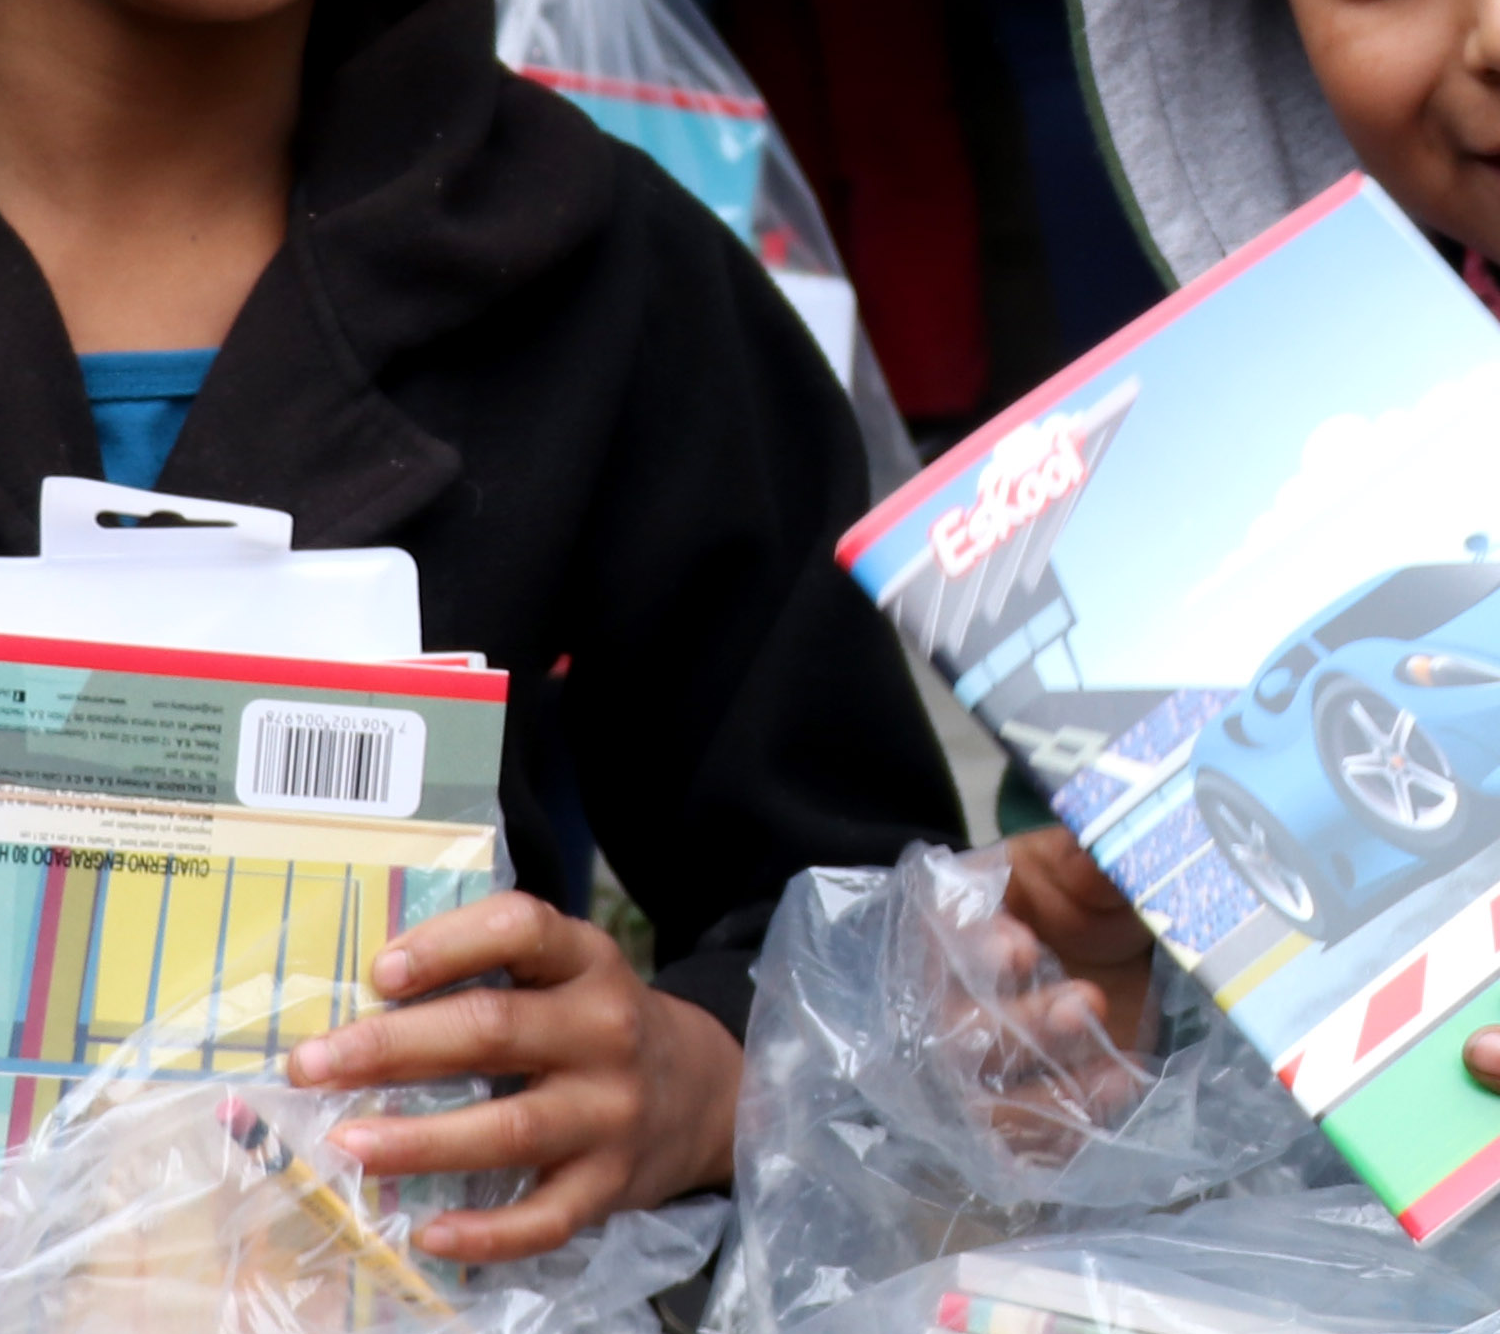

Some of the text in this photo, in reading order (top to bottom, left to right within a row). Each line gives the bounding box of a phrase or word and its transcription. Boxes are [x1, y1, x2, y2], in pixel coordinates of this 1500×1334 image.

[930, 424, 1086, 578] Eskool
[265, 710, 325, 728] 004978
[398, 721, 408, 735] 7
[12, 844, 29, 866] 80
[33, 848, 124, 871] ENGRAPADO
[129, 855, 210, 878] CUADERNO
